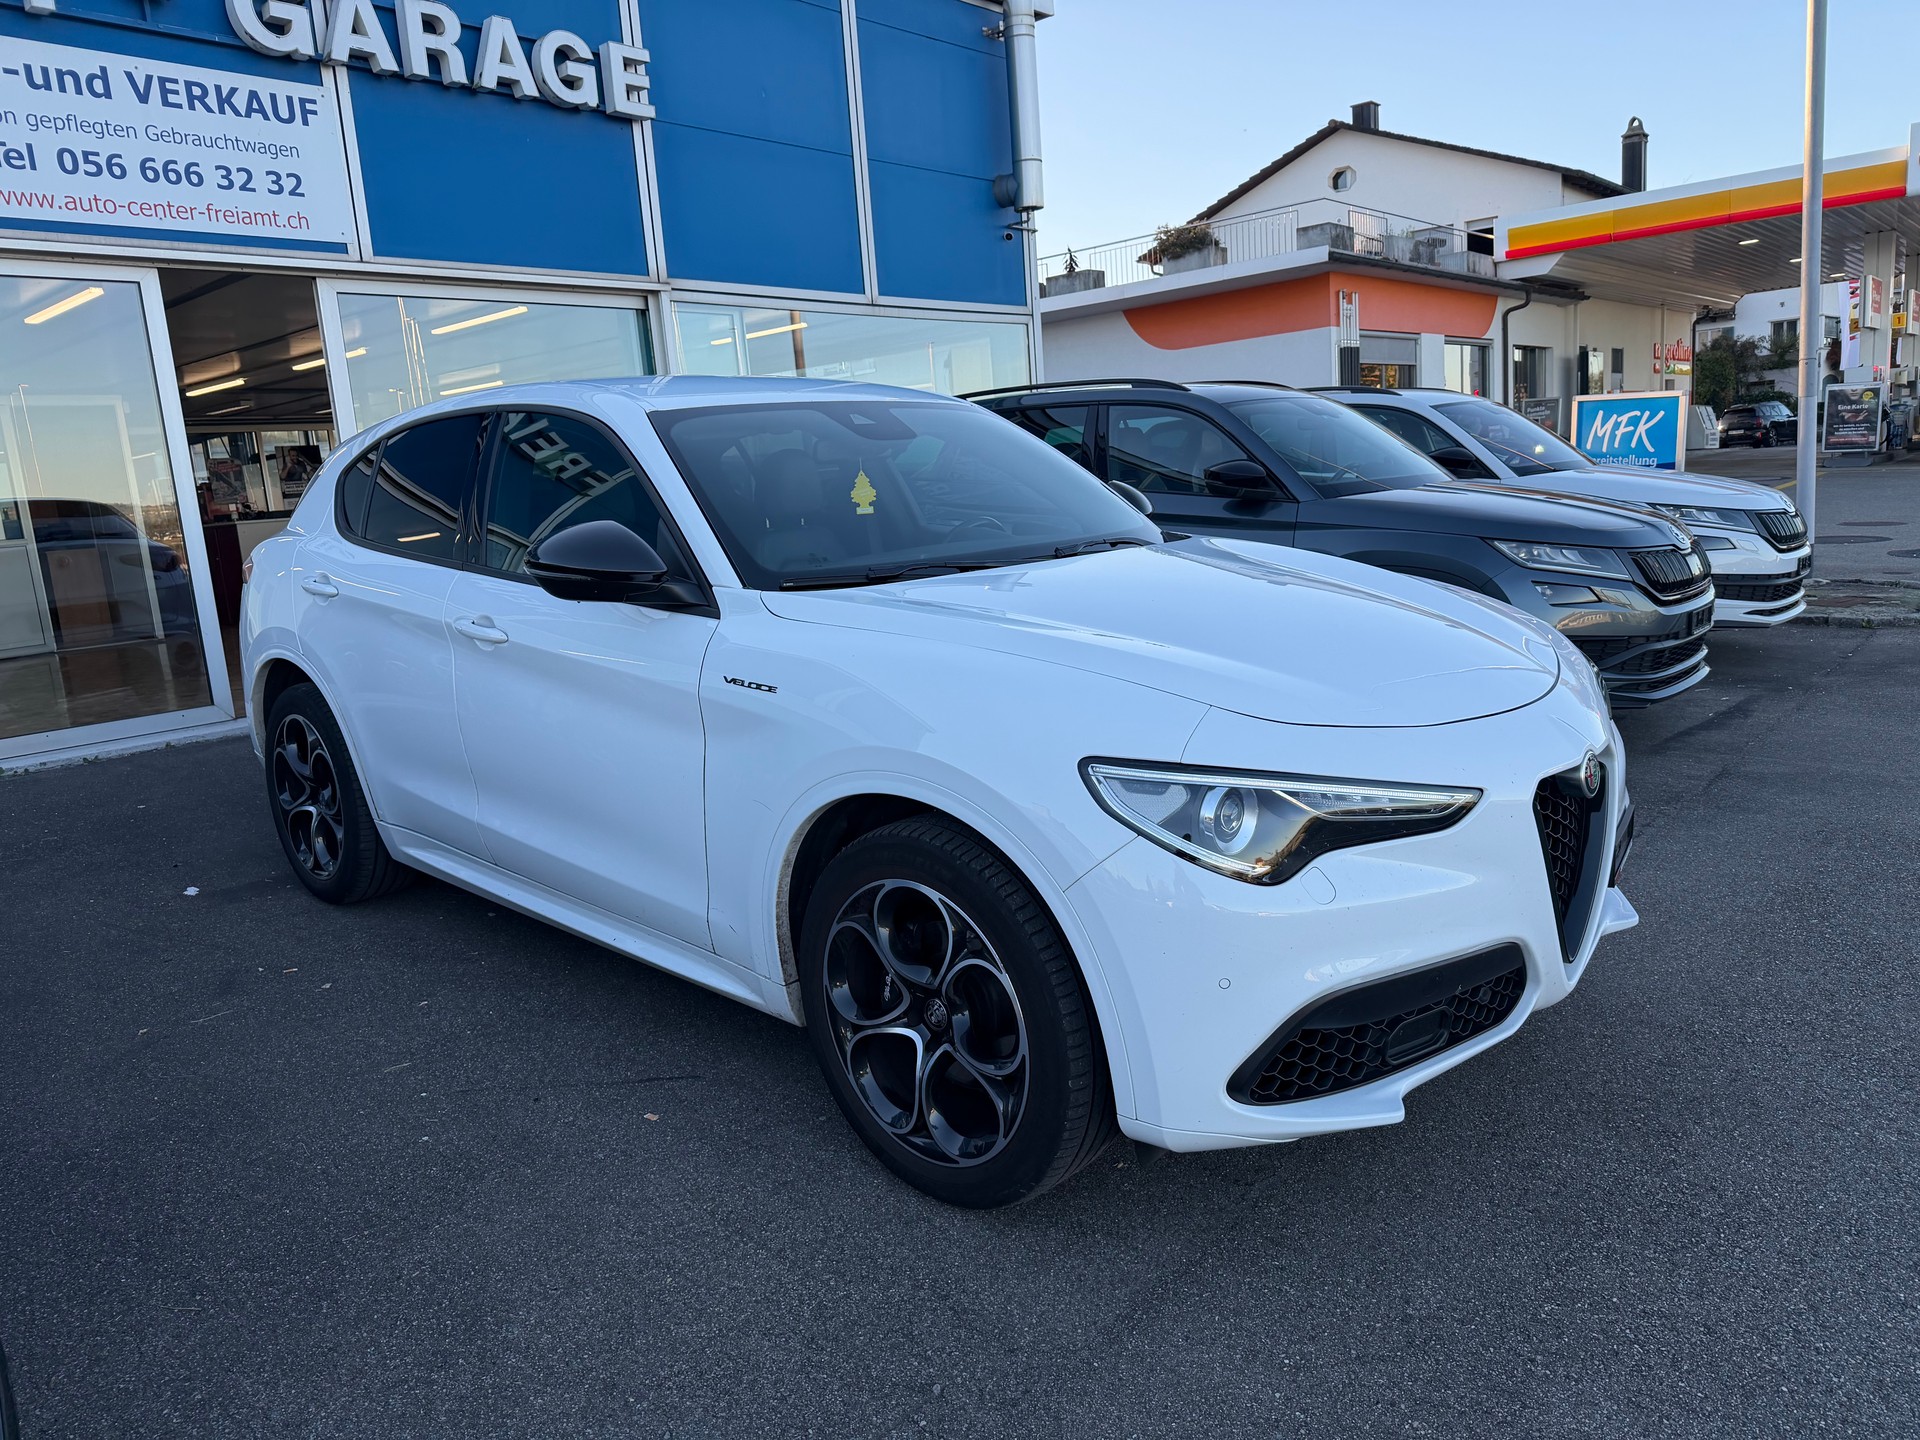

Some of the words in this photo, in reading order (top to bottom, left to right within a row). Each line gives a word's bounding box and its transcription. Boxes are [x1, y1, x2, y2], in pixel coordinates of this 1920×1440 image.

[226, 0, 656, 120] GARAGE
[123, 69, 319, 127] VERKAUF
[25, 112, 138, 140] gepflegten
[144, 124, 300, 160] Gebrauchtwagen
[56, 147, 127, 180] 056
[139, 157, 204, 188] 666
[214, 164, 257, 193] 32
[265, 170, 306, 198] 32
[1586, 410, 1665, 453] MFK
[1592, 454, 1657, 468] reitstellung
[723, 675, 778, 694] VELOCE
